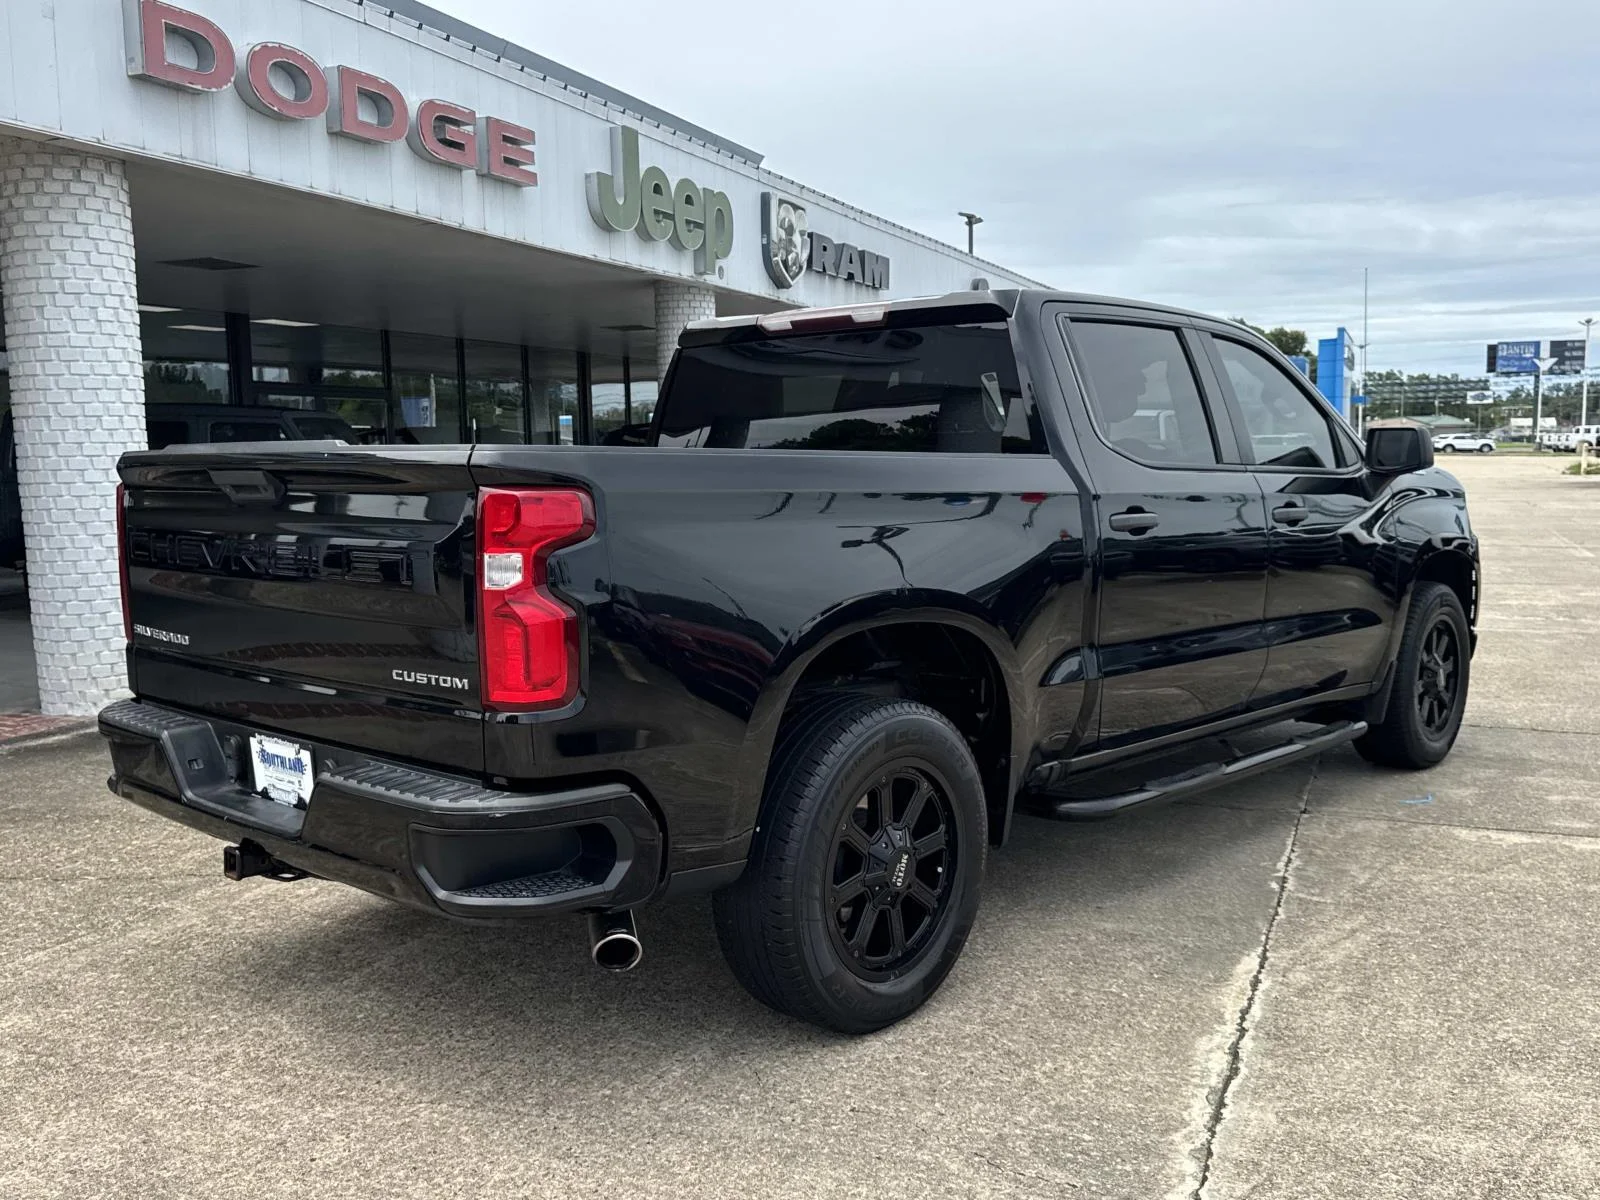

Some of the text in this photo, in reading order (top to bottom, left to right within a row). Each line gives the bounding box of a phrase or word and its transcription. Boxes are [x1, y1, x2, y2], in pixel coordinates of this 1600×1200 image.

[127, 0, 537, 187] DODGE
[585, 125, 734, 275] Jeep
[808, 231, 890, 290] RAM
[134, 623, 190, 645] SILVERADO
[391, 668, 470, 690] CUSTOM
[896, 853, 909, 887] MOTO
